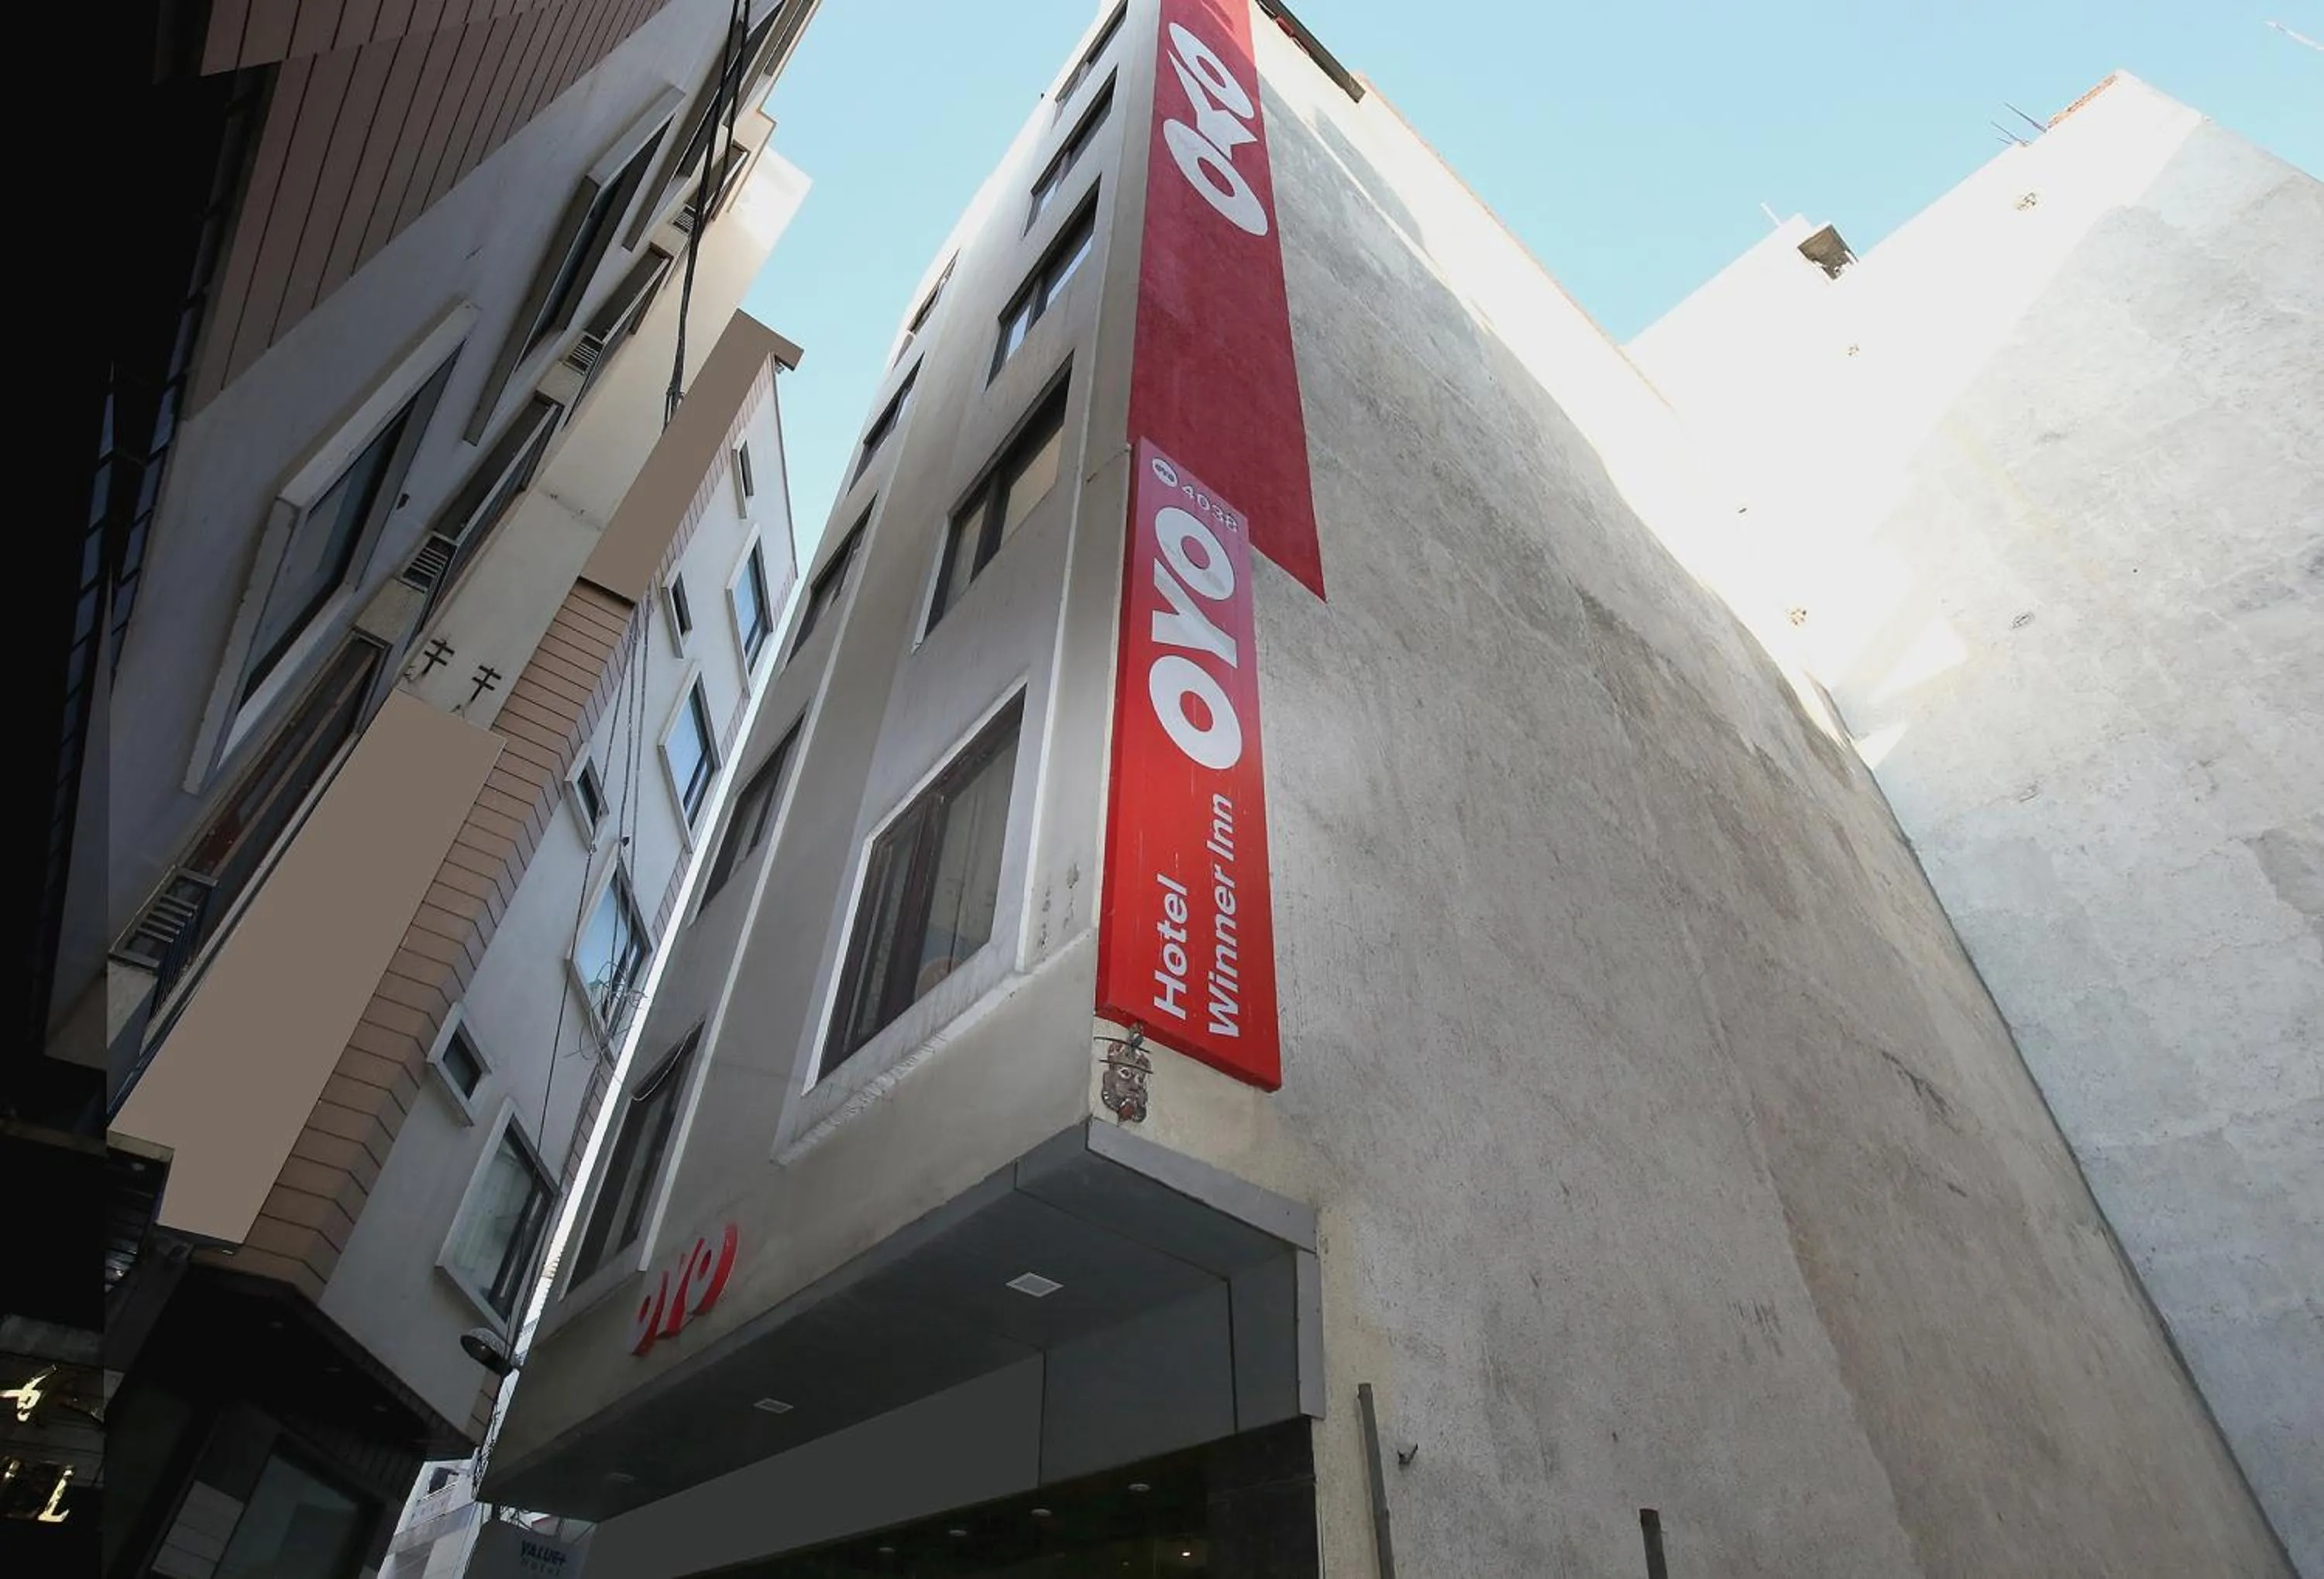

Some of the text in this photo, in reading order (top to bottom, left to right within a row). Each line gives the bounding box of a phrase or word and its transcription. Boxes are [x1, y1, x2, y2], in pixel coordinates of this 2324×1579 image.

[1164, 22, 1268, 236] OYO
[1149, 506, 1243, 769] OYO
[1153, 874, 1188, 1020] Hotel
[1206, 793, 1239, 1037] Winner Inn
